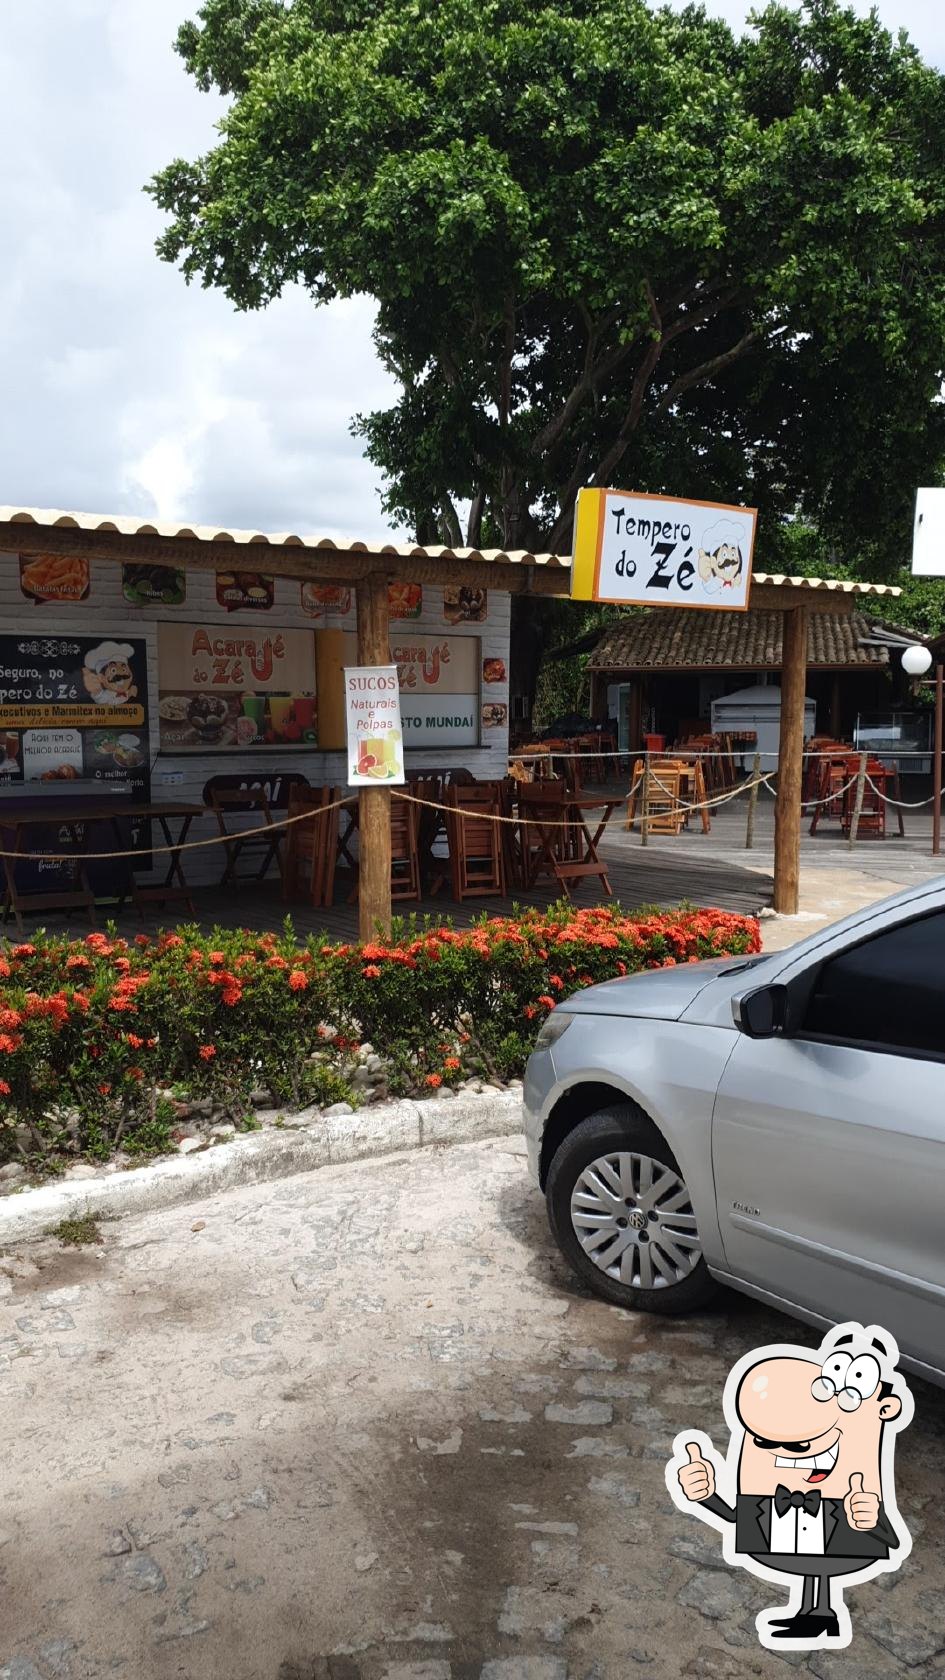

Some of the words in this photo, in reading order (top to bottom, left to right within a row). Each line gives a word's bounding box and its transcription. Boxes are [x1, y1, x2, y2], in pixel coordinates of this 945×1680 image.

[611, 507, 691, 547] Tempero
[615, 550, 637, 578] do
[645, 541, 696, 591] Zé
[49, 669, 64, 681] no
[193, 667, 208, 683] do
[212, 658, 244, 685] Zé
[349, 676, 396, 691] SUCOS
[35, 684, 53, 699] do
[56, 684, 78, 699] Zé
[350, 698, 397, 710] Naturais
[356, 720, 393, 731] Polpas
[426, 715, 473, 728] MUNDAÍ
